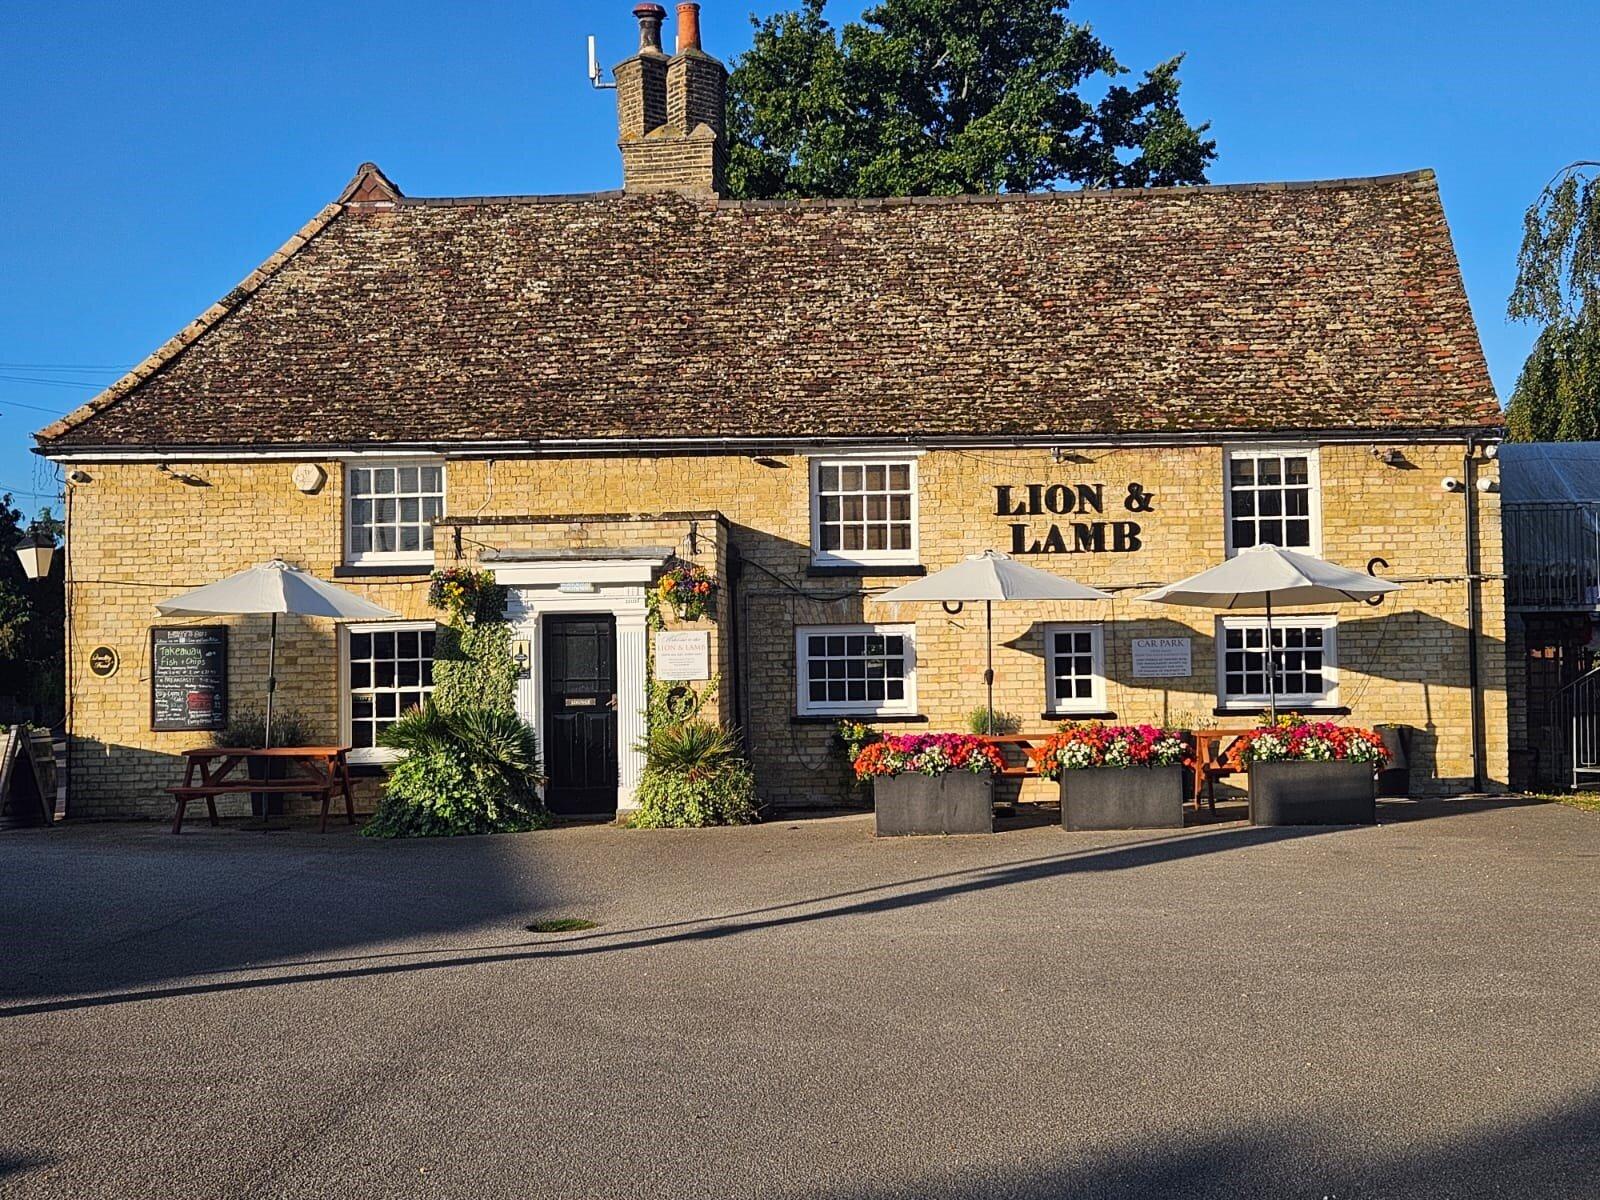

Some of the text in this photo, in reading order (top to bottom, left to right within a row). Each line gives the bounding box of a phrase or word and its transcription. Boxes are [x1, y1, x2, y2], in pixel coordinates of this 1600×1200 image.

[992, 482, 1156, 516] LION &
[1008, 521, 1142, 554] LAMB
[160, 646, 202, 659] Takeaway
[1137, 639, 1185, 648] CAR PARK
